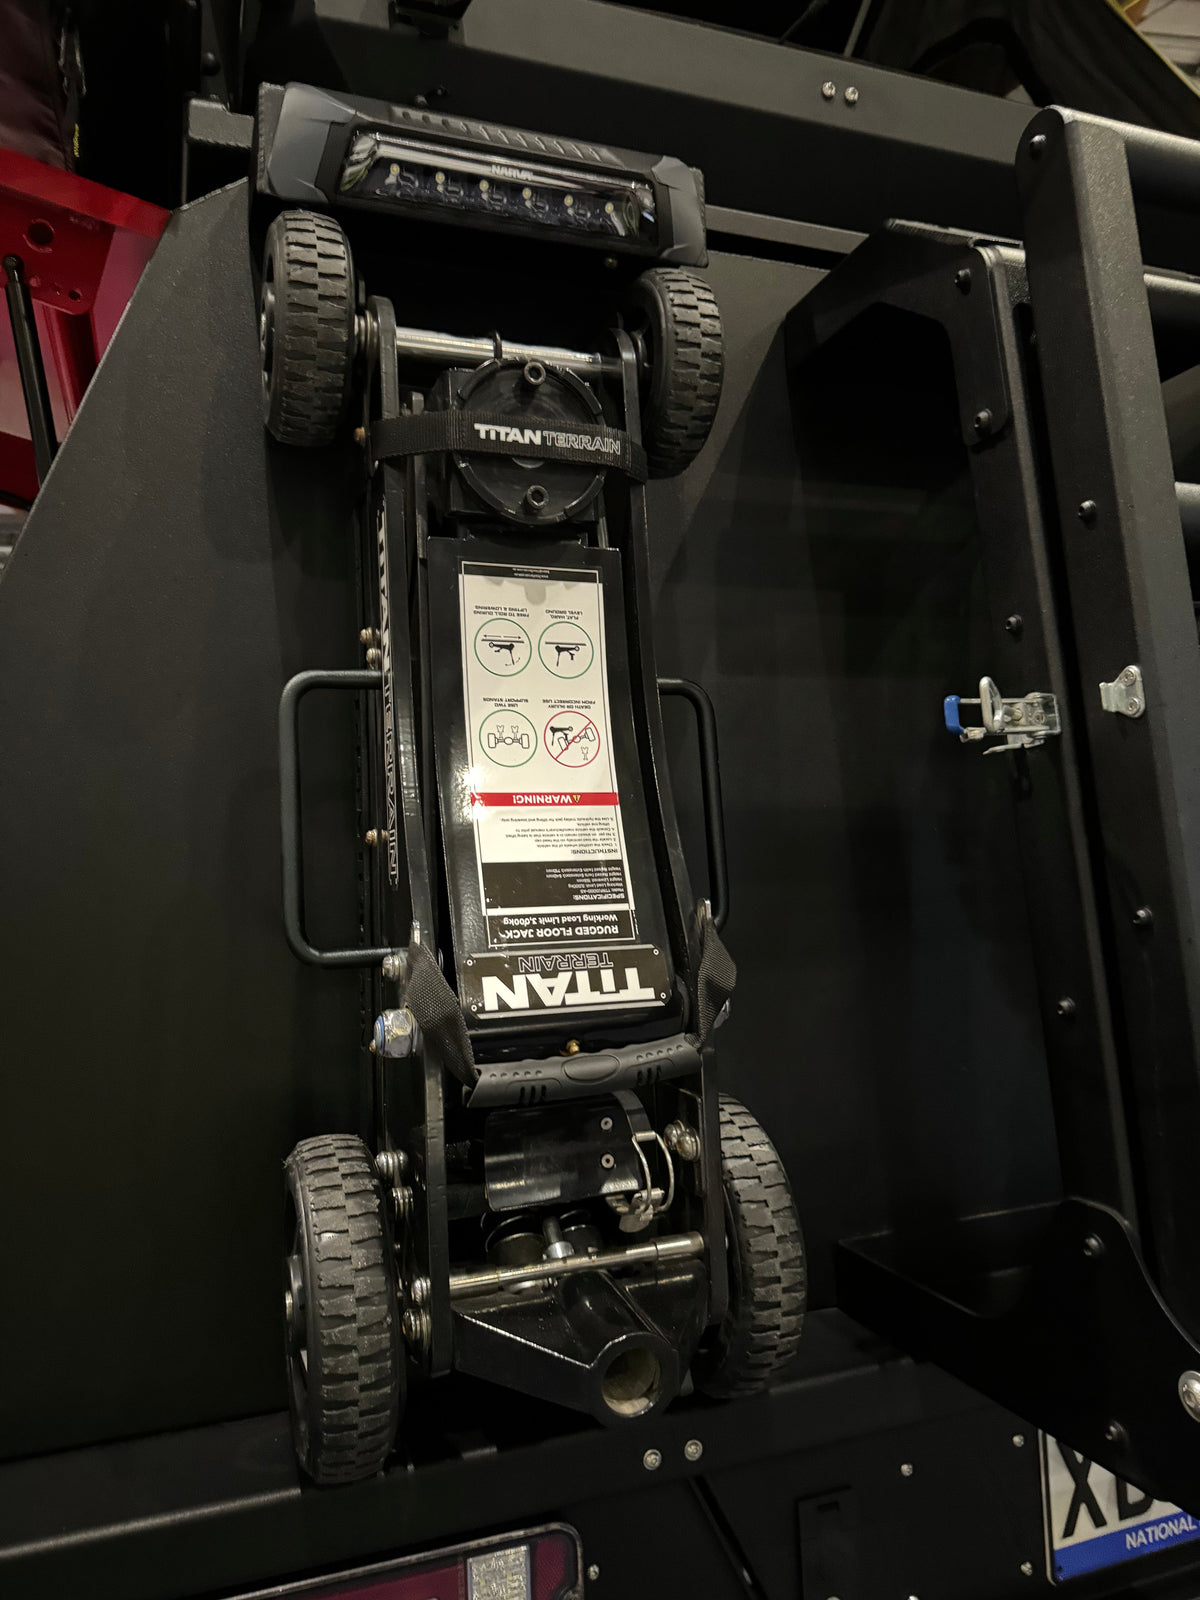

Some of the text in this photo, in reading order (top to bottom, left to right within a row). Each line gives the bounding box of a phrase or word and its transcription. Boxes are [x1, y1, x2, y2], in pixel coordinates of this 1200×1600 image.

[474, 423, 621, 455] TITAN TERRAIN
[512, 795, 572, 804] WARNING!
[503, 916, 537, 926] 3,000kg
[582, 913, 618, 922] Working
[505, 925, 619, 939] RUGGED FLOOR JACK
[518, 952, 614, 973] TERRAIN
[482, 968, 655, 1011] TITAN
[1125, 1516, 1198, 1549] NATIONAL
